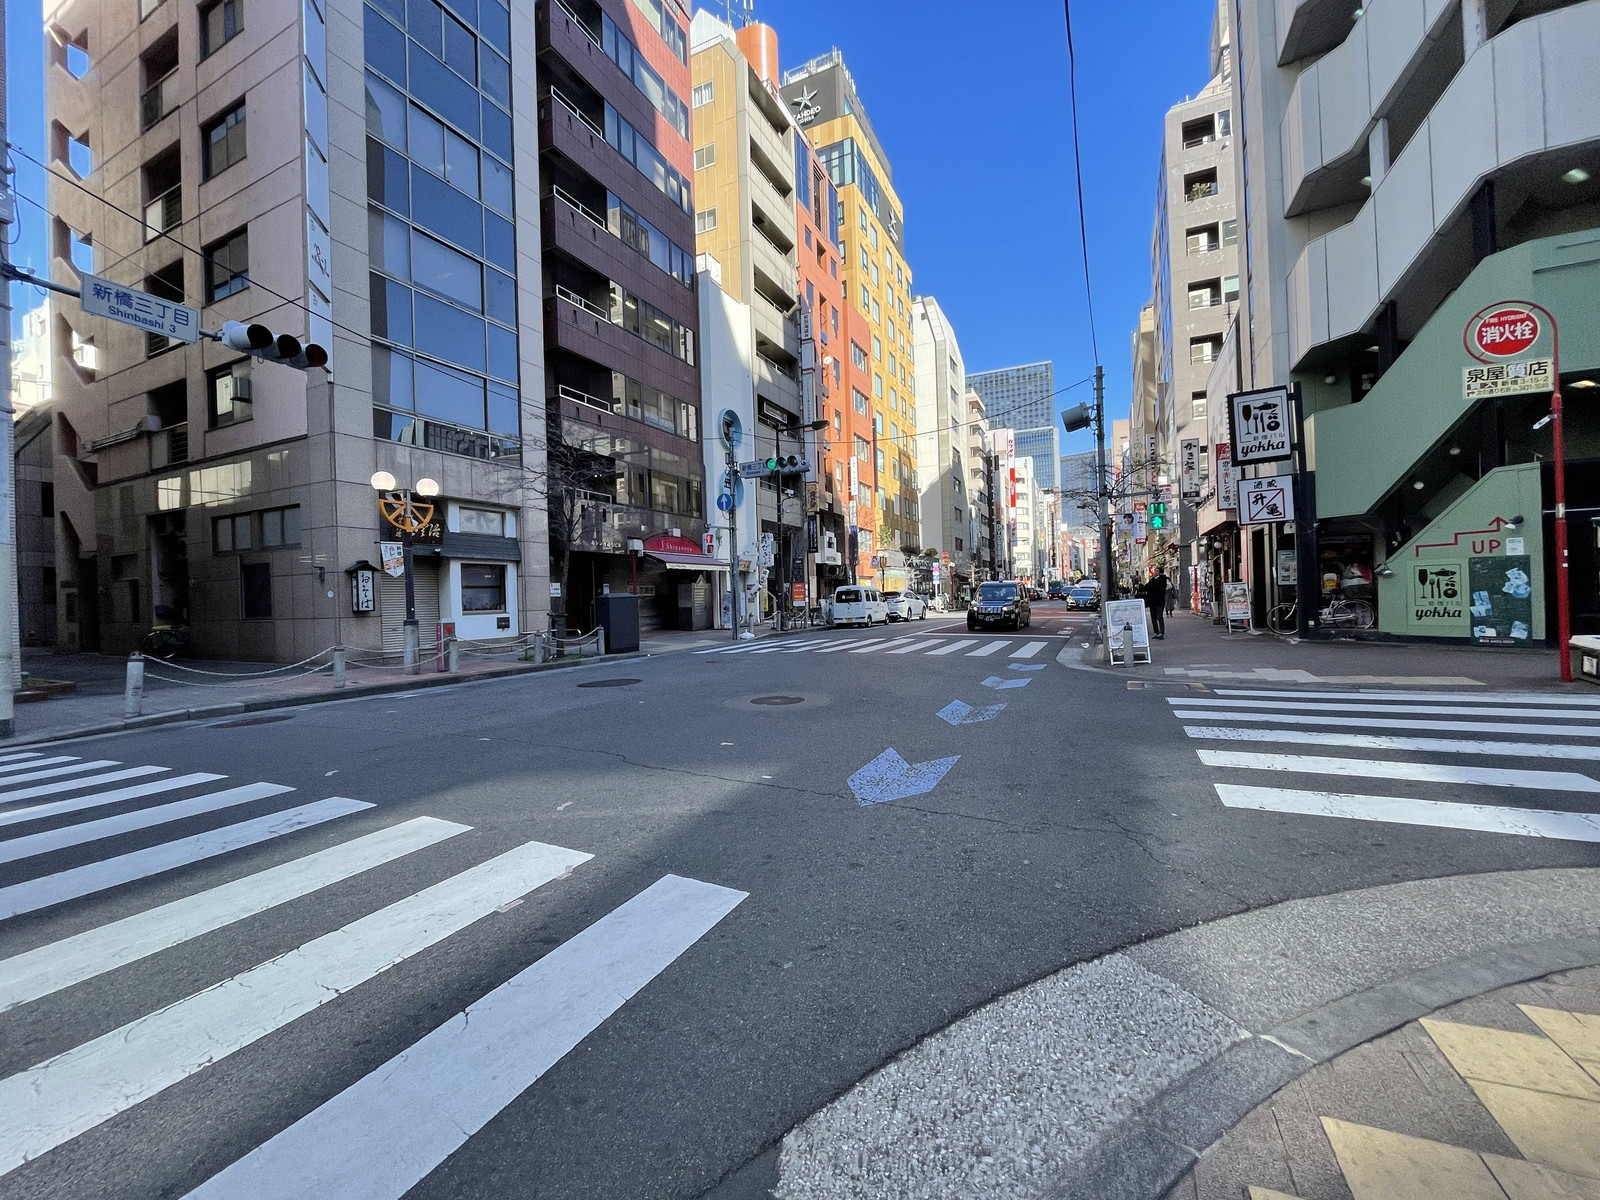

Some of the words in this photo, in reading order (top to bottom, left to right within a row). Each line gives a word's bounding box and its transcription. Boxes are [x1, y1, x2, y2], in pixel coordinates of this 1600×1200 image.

[793, 105, 821, 119] ANDEO
[92, 282, 189, 326] 新橋三丁目
[108, 305, 164, 330] Shinbashi
[168, 324, 176, 333] 3
[1481, 321, 1533, 345] 消火栓
[1467, 361, 1548, 383] 泉屋質店
[1241, 440, 1285, 457] yokka
[1472, 539, 1501, 554] UP
[1415, 607, 1461, 620] yokka
